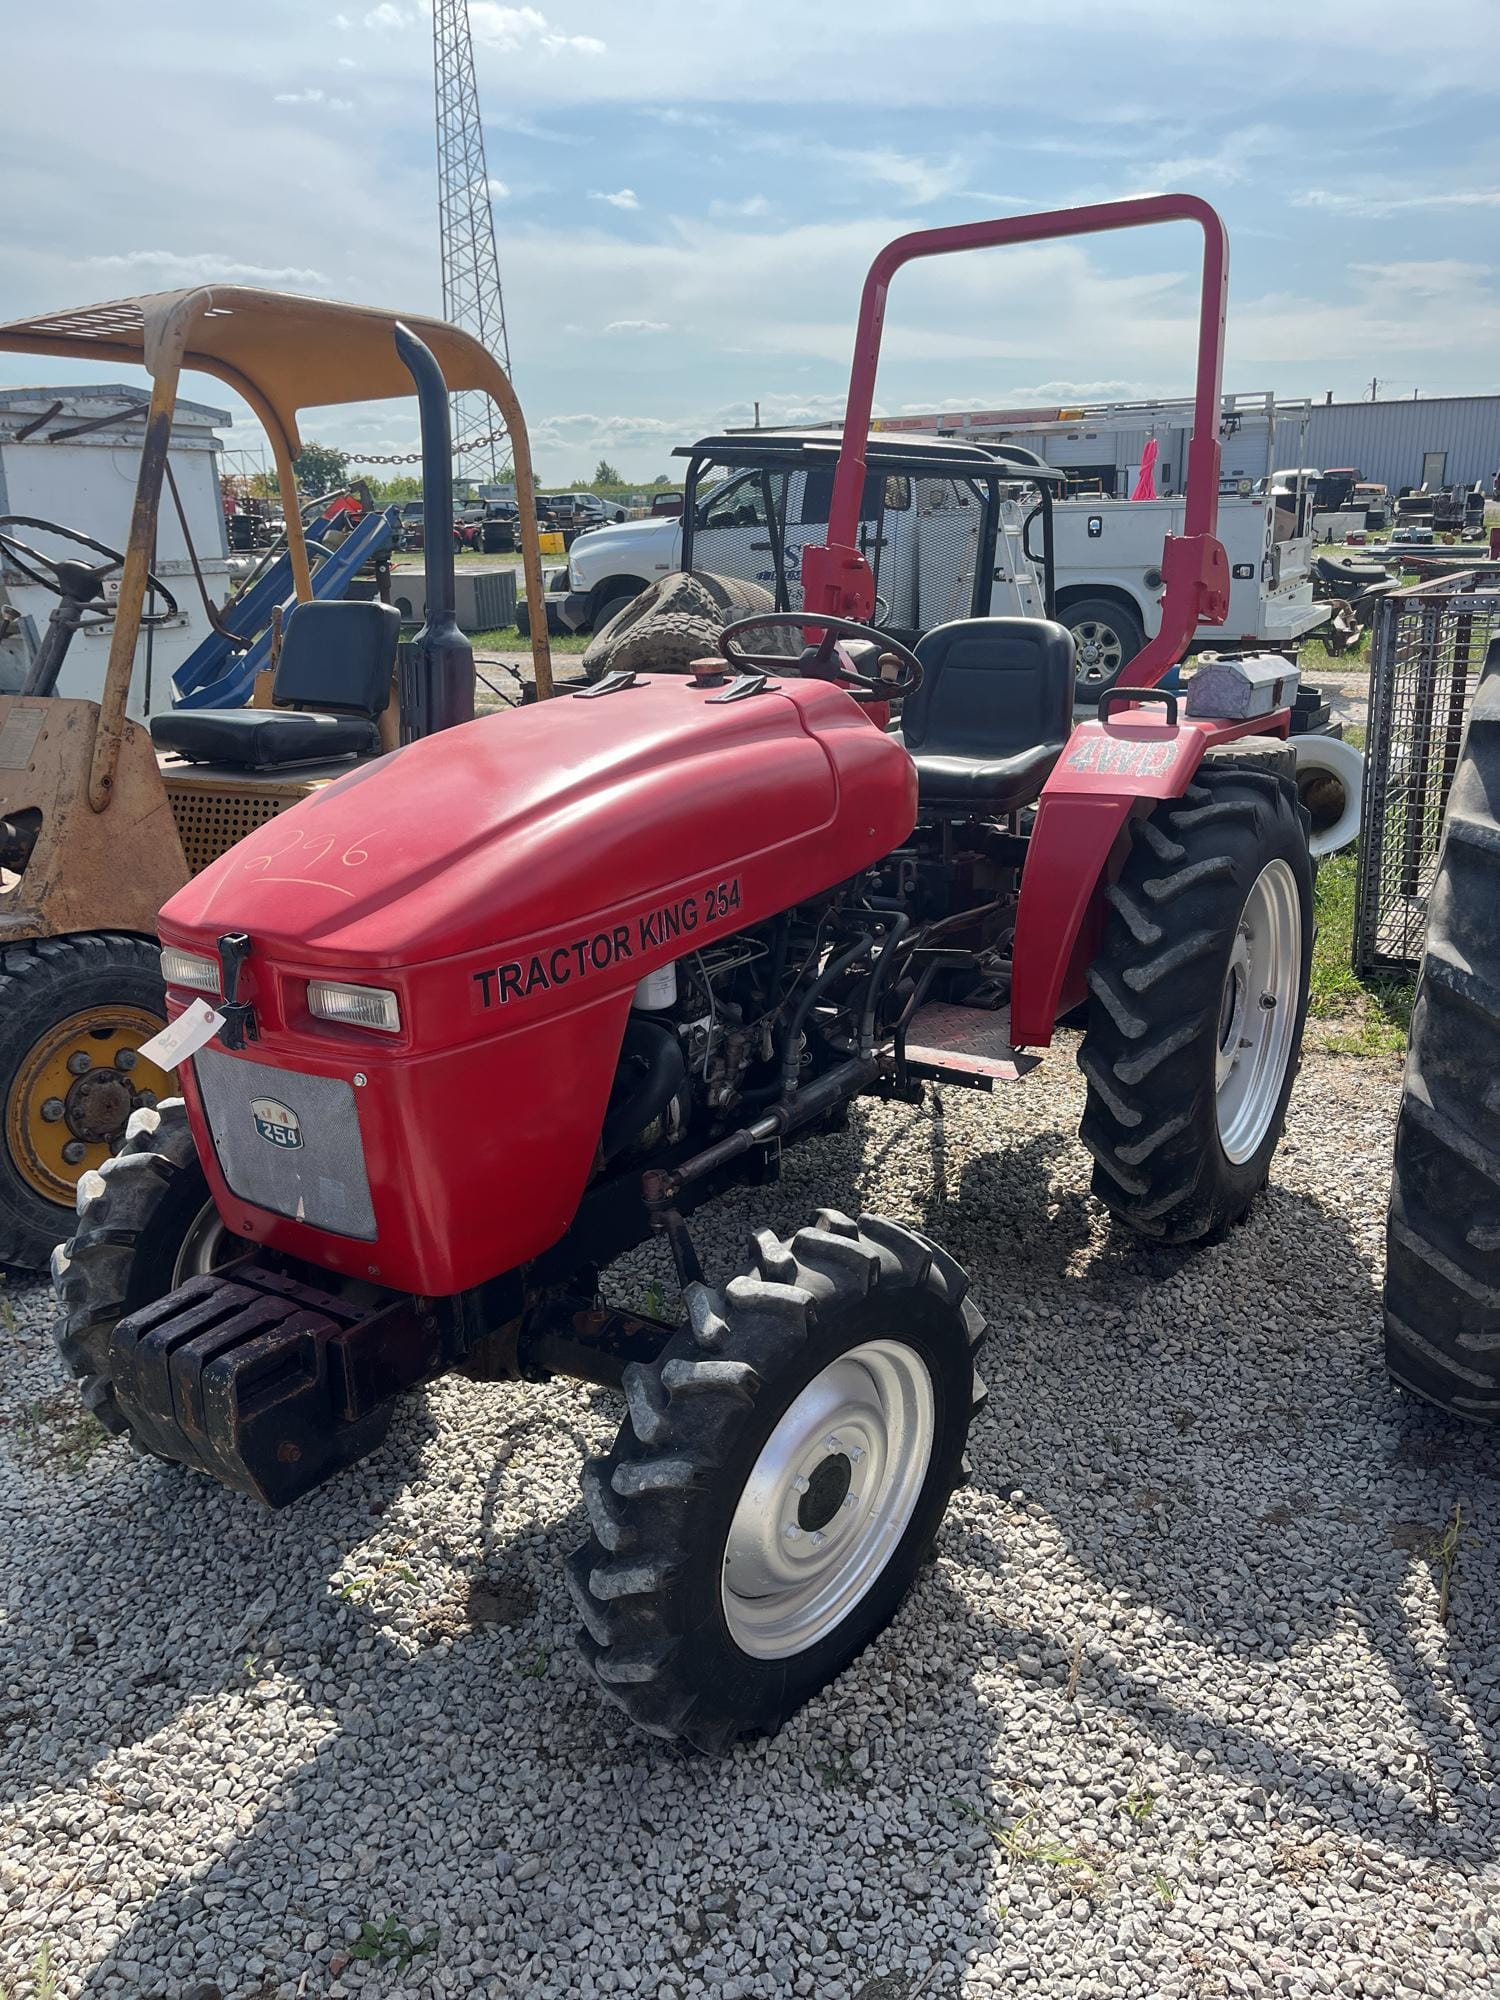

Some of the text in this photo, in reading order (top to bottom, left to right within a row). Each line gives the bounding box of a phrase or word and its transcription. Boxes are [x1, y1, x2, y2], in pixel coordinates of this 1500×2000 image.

[1067, 737, 1177, 777] 4WD
[244, 829, 387, 872] 296
[472, 879, 741, 1009] TRACTOR KING 254
[262, 1122, 298, 1145] 254
